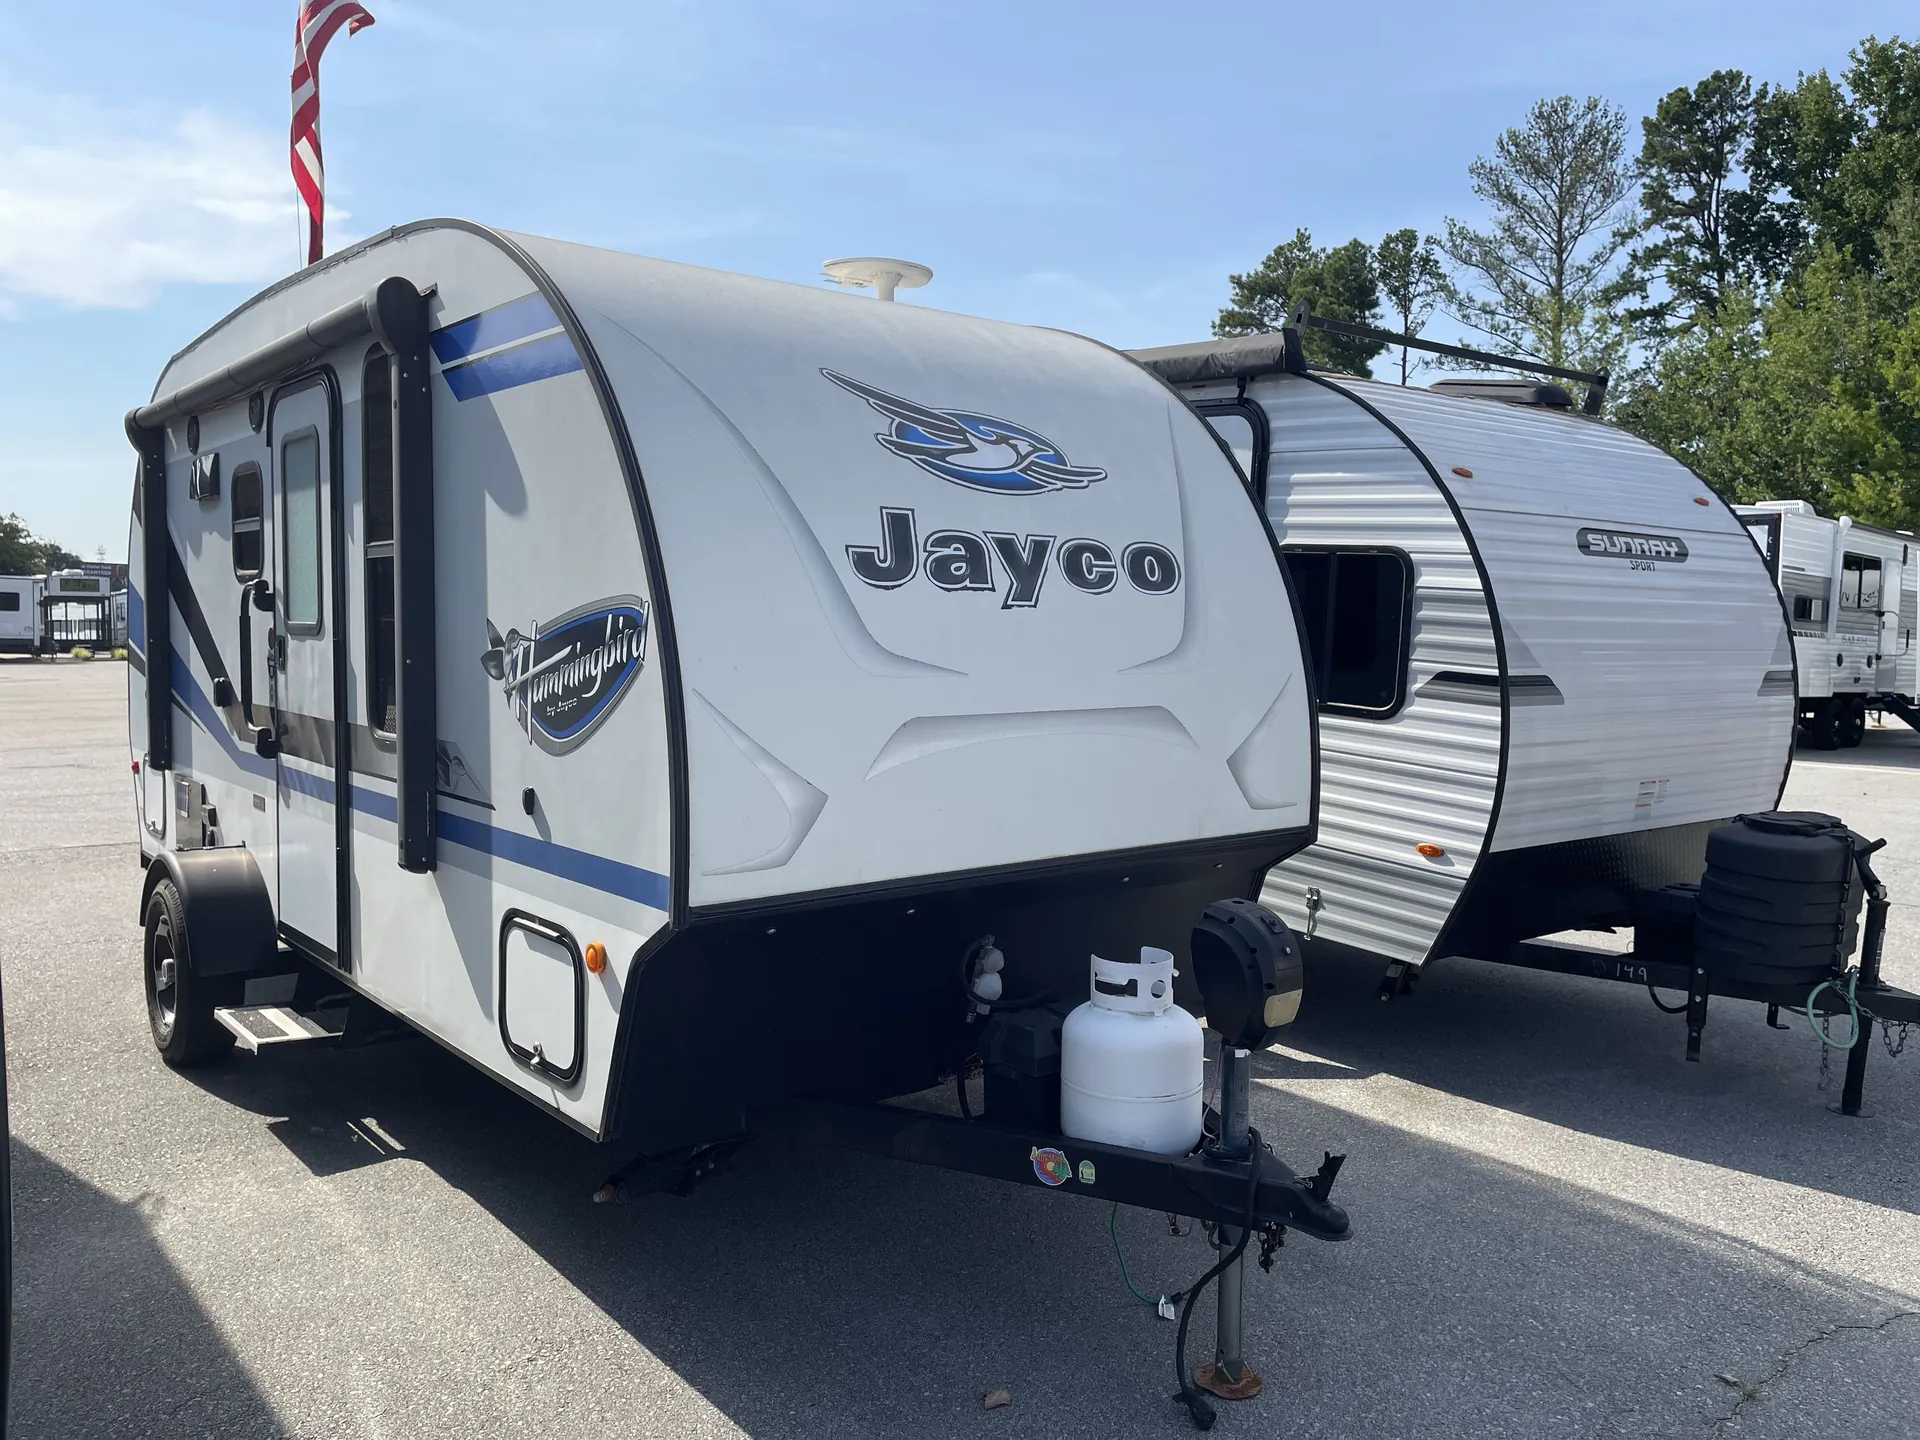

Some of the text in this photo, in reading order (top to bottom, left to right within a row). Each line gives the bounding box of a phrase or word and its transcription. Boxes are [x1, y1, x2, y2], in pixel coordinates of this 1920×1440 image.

[845, 506, 1181, 609] Jayco
[1586, 533, 1679, 558] SUNRAY
[1629, 560, 1656, 572] SPORT
[503, 600, 650, 745] Hummingbird
[1616, 962, 1647, 982] 149
